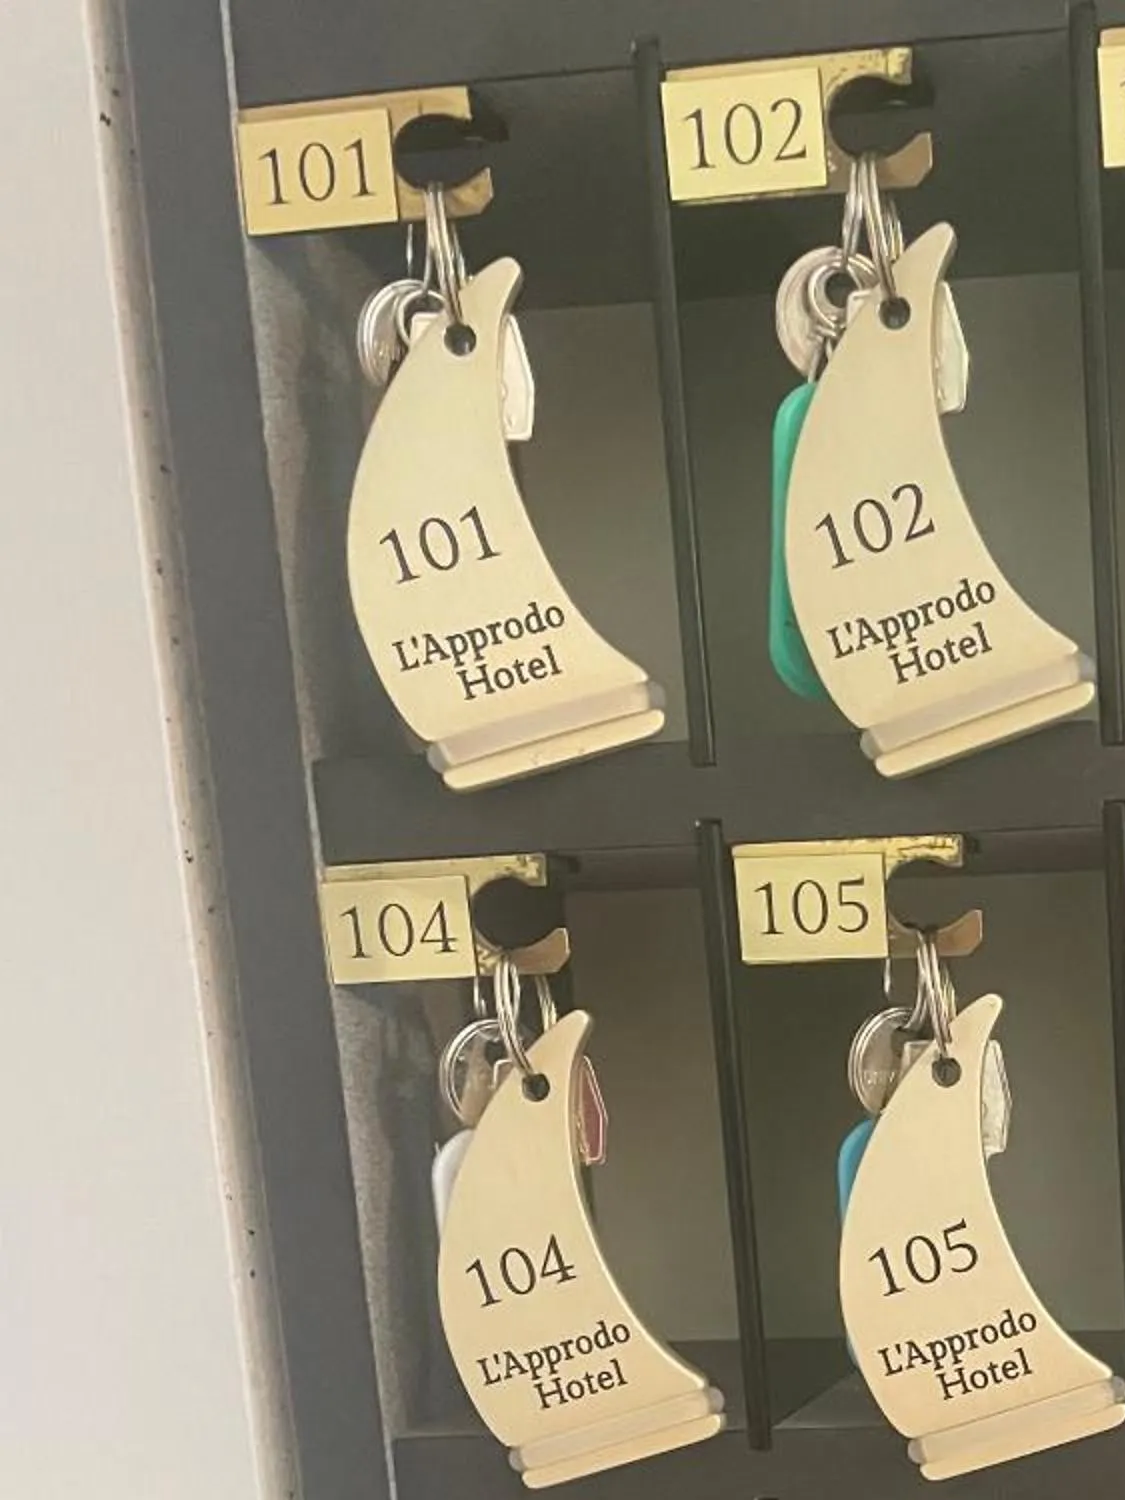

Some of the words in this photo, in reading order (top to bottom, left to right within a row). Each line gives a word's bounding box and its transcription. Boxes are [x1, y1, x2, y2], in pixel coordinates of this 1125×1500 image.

[684, 97, 807, 170] 102
[259, 138, 374, 205] 101
[379, 505, 501, 585] 101
[815, 483, 935, 569] 102
[391, 601, 565, 672] L'Approdo
[825, 577, 996, 659] L'Approdo
[455, 644, 563, 701] Hotel
[888, 621, 993, 685] Hotel
[340, 900, 458, 959] 104
[754, 876, 869, 935] 105
[465, 1234, 577, 1308] 104
[868, 1217, 979, 1297] 105
[476, 1319, 631, 1386] L'Approdo
[877, 1308, 1037, 1377] L'Approdo
[935, 1347, 1033, 1401] Hotel
[533, 1358, 629, 1410] Hotel
